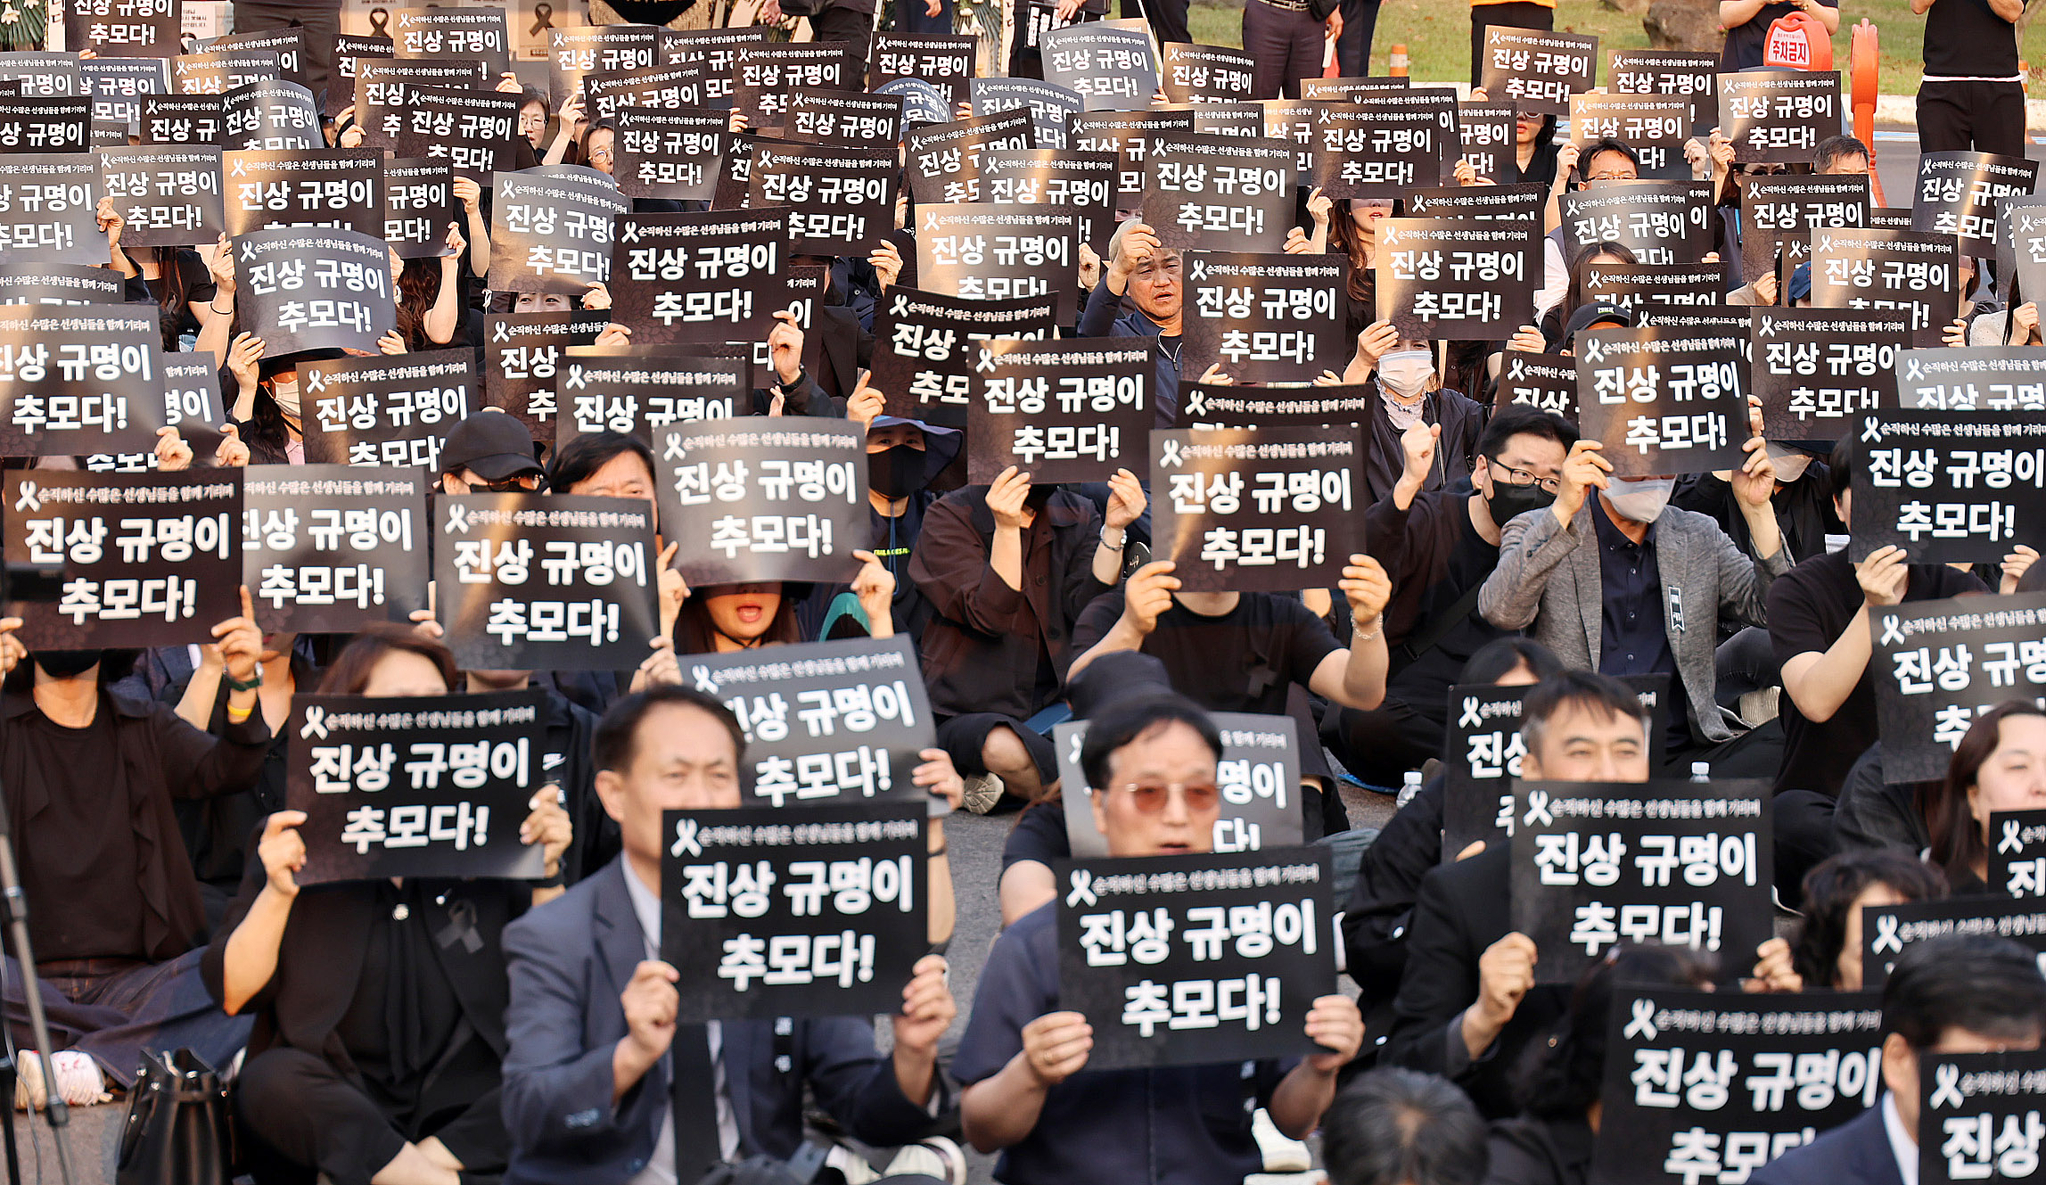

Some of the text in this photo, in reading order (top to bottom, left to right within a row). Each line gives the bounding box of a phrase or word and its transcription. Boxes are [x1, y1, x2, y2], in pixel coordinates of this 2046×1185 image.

[404, 30, 500, 52] 진상 규명이
[1773, 40, 1806, 62] 주차금지
[559, 47, 652, 73] 진상 규명이
[743, 64, 840, 86] 진상 규명이
[880, 54, 968, 76] 진상 규명이
[1053, 49, 1148, 72] 진상 규명이
[1493, 49, 1588, 77] 진상 규명이
[1074, 76, 1138, 98] 추모다!
[1506, 77, 1570, 103] 추모다!
[1617, 72, 1711, 95] 진상 규명이
[1731, 95, 1831, 118] 진상 규명이
[623, 130, 718, 155] 진상 규명이
[1166, 143, 1289, 159] 순직하신 수많은 선생님들을 함께 기리며
[1323, 128, 1430, 152] 진상 규명이
[1748, 126, 1815, 150] 추모다!
[111, 154, 216, 164] 순직하신 수많은 선생님들을 함께 기리며
[638, 162, 702, 186] 추모다!
[772, 155, 892, 168] 순직하신 수많은 선생님들을 함께 기리며
[1341, 161, 1413, 185] 추모다!
[104, 171, 217, 196] 진상 규명이
[237, 179, 372, 212] 진상 규명이
[762, 174, 887, 204] 진상 규명이
[1157, 163, 1285, 197] 진상 규명이
[127, 204, 201, 231] 추모다!
[506, 205, 557, 234] 진상
[638, 220, 780, 236] 순직하신 수많은 선생님들을 함께 기리며
[1177, 202, 1263, 235] 추모다!
[628, 242, 776, 280] 진상 규명이
[933, 235, 1068, 266] 진상 규명이
[1390, 249, 1523, 281] 진상 규명이
[249, 259, 385, 298] 진상 규명이
[1206, 265, 1339, 276] 순직하신 수많은 선생님들을 함께 기리며
[1824, 258, 1949, 292] 진상 규명이
[278, 301, 371, 332] 추모다!
[653, 289, 752, 325] 추모다!
[1196, 286, 1335, 319] 진상 규명이
[1413, 291, 1500, 322] 추모다!
[1774, 320, 1904, 332] 순직하신 수많은 선생님들을 함께 기리며
[58, 344, 151, 381] 규명이
[994, 350, 1147, 365] 순직하신 수많은 선생님들을 함께 기리며
[1220, 330, 1314, 364] 추모다!
[1766, 342, 1901, 374] 진상 규명이
[324, 362, 467, 384] 순직하신 수많은 선생님들을 함께 기리며
[1594, 362, 1740, 404] 진상 규명이
[317, 386, 467, 432] 진상 규명이
[984, 374, 1143, 413] 진상 규명이
[12, 394, 126, 434] 추모다!
[1012, 424, 1119, 463] 추모다!
[1626, 412, 1726, 453] 추모다!
[674, 460, 856, 505] 진상 규명이
[1869, 448, 2044, 488] 진상 규명이
[1170, 469, 1351, 514] 진상 규명이
[308, 508, 412, 551] 규명이
[711, 514, 832, 558] 추모다!
[1897, 501, 2014, 541] 추모다!
[25, 513, 228, 563] 진상 규명이
[1201, 525, 1325, 570] 추모다!
[455, 540, 646, 586] 진상 규명이
[59, 576, 196, 625] 추모다!
[259, 564, 384, 608] 추모다!
[487, 599, 619, 646] 추모다!
[798, 681, 914, 736] 규명이
[310, 738, 528, 793] 진상 규명이
[755, 746, 891, 807] 추모다!
[341, 802, 489, 854] 추모다!
[1535, 833, 1756, 886] 진상 규명이
[682, 856, 912, 918] 진상 규명이
[1080, 899, 1316, 966] 진상 규명이
[718, 930, 875, 991] 추모다!
[1122, 974, 1280, 1037] 추모다!
[1632, 1048, 1882, 1111] 진상 규명이
